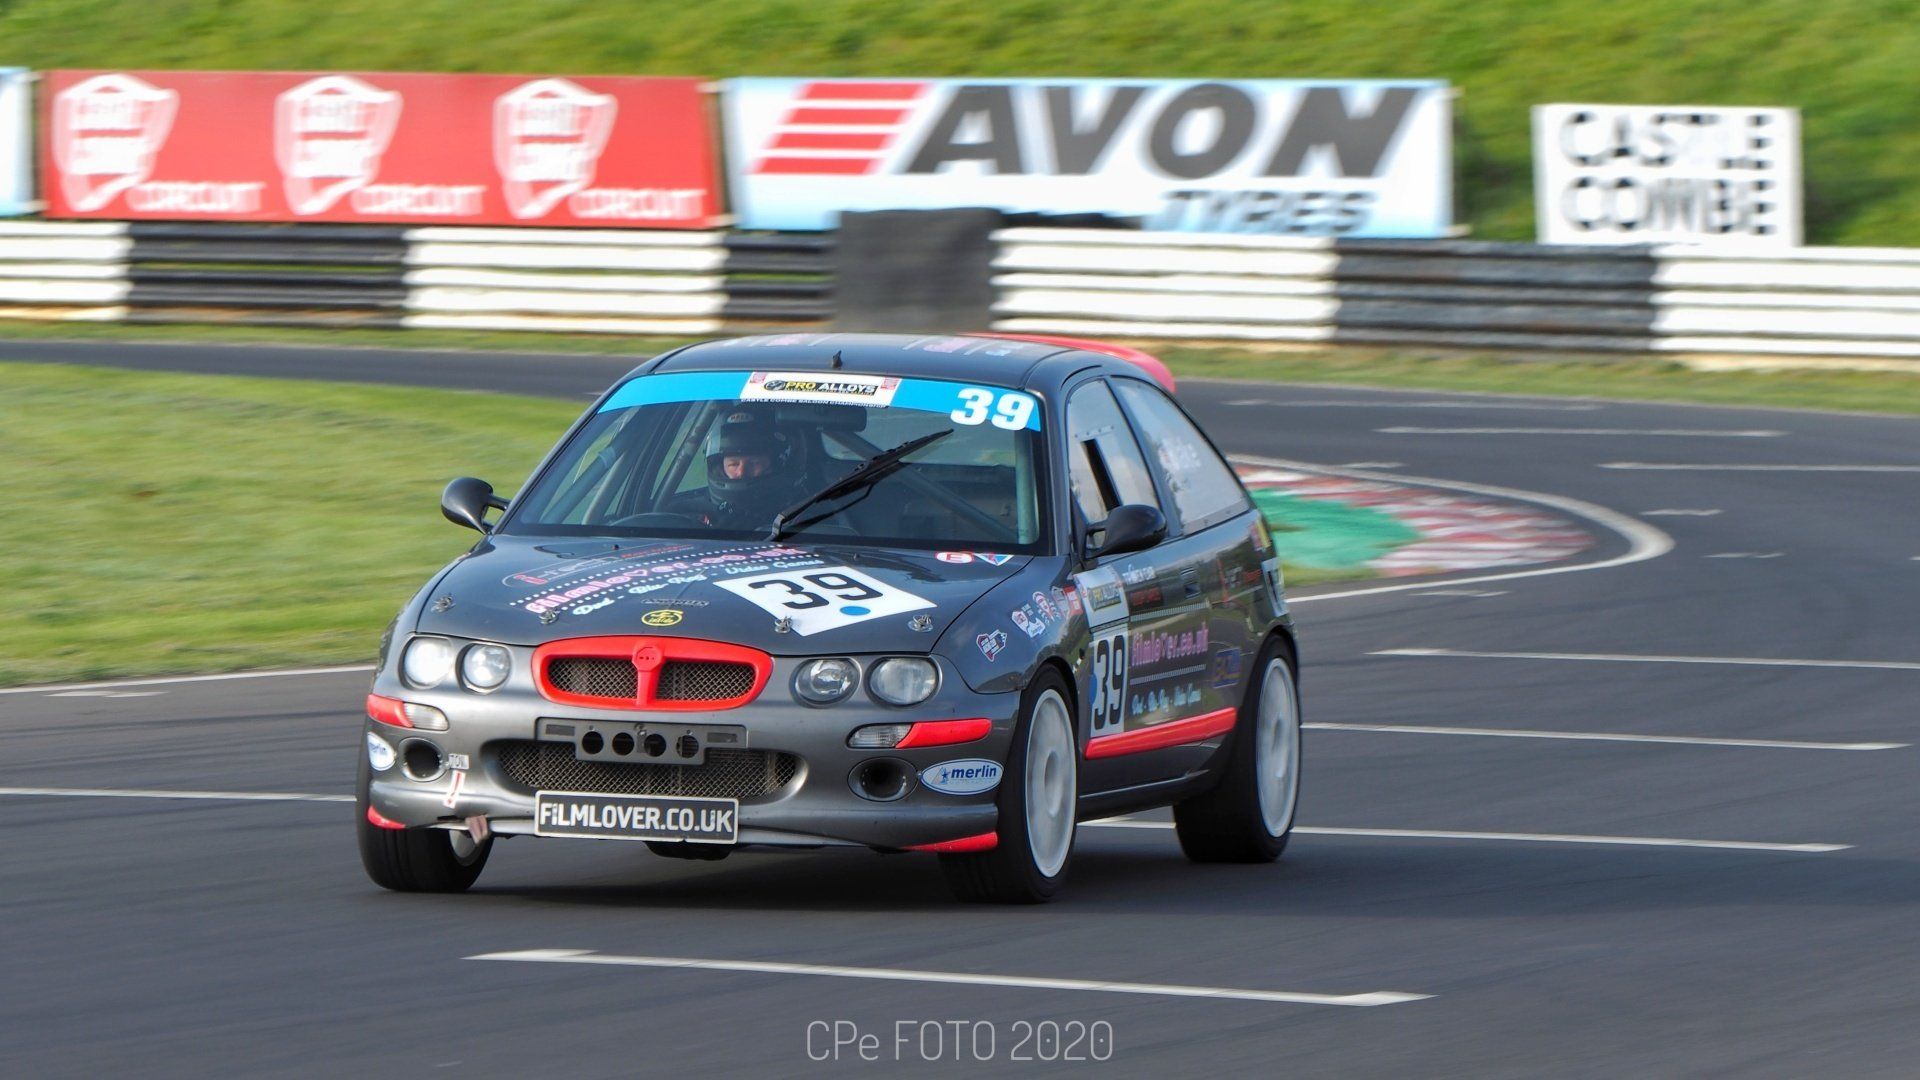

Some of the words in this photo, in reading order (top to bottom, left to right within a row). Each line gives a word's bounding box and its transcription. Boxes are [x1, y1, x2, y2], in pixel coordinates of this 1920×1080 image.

[902, 83, 1422, 180] AVON
[1558, 110, 1776, 170] CASTLE
[1157, 189, 1376, 237] TYRES
[1559, 175, 1778, 236] COMBE
[786, 380, 817, 391] PRO
[818, 382, 877, 394] ALLOYS
[950, 387, 1035, 431] 39
[748, 573, 882, 610] 39
[1094, 634, 1125, 730] 39
[950, 764, 998, 779] merlin
